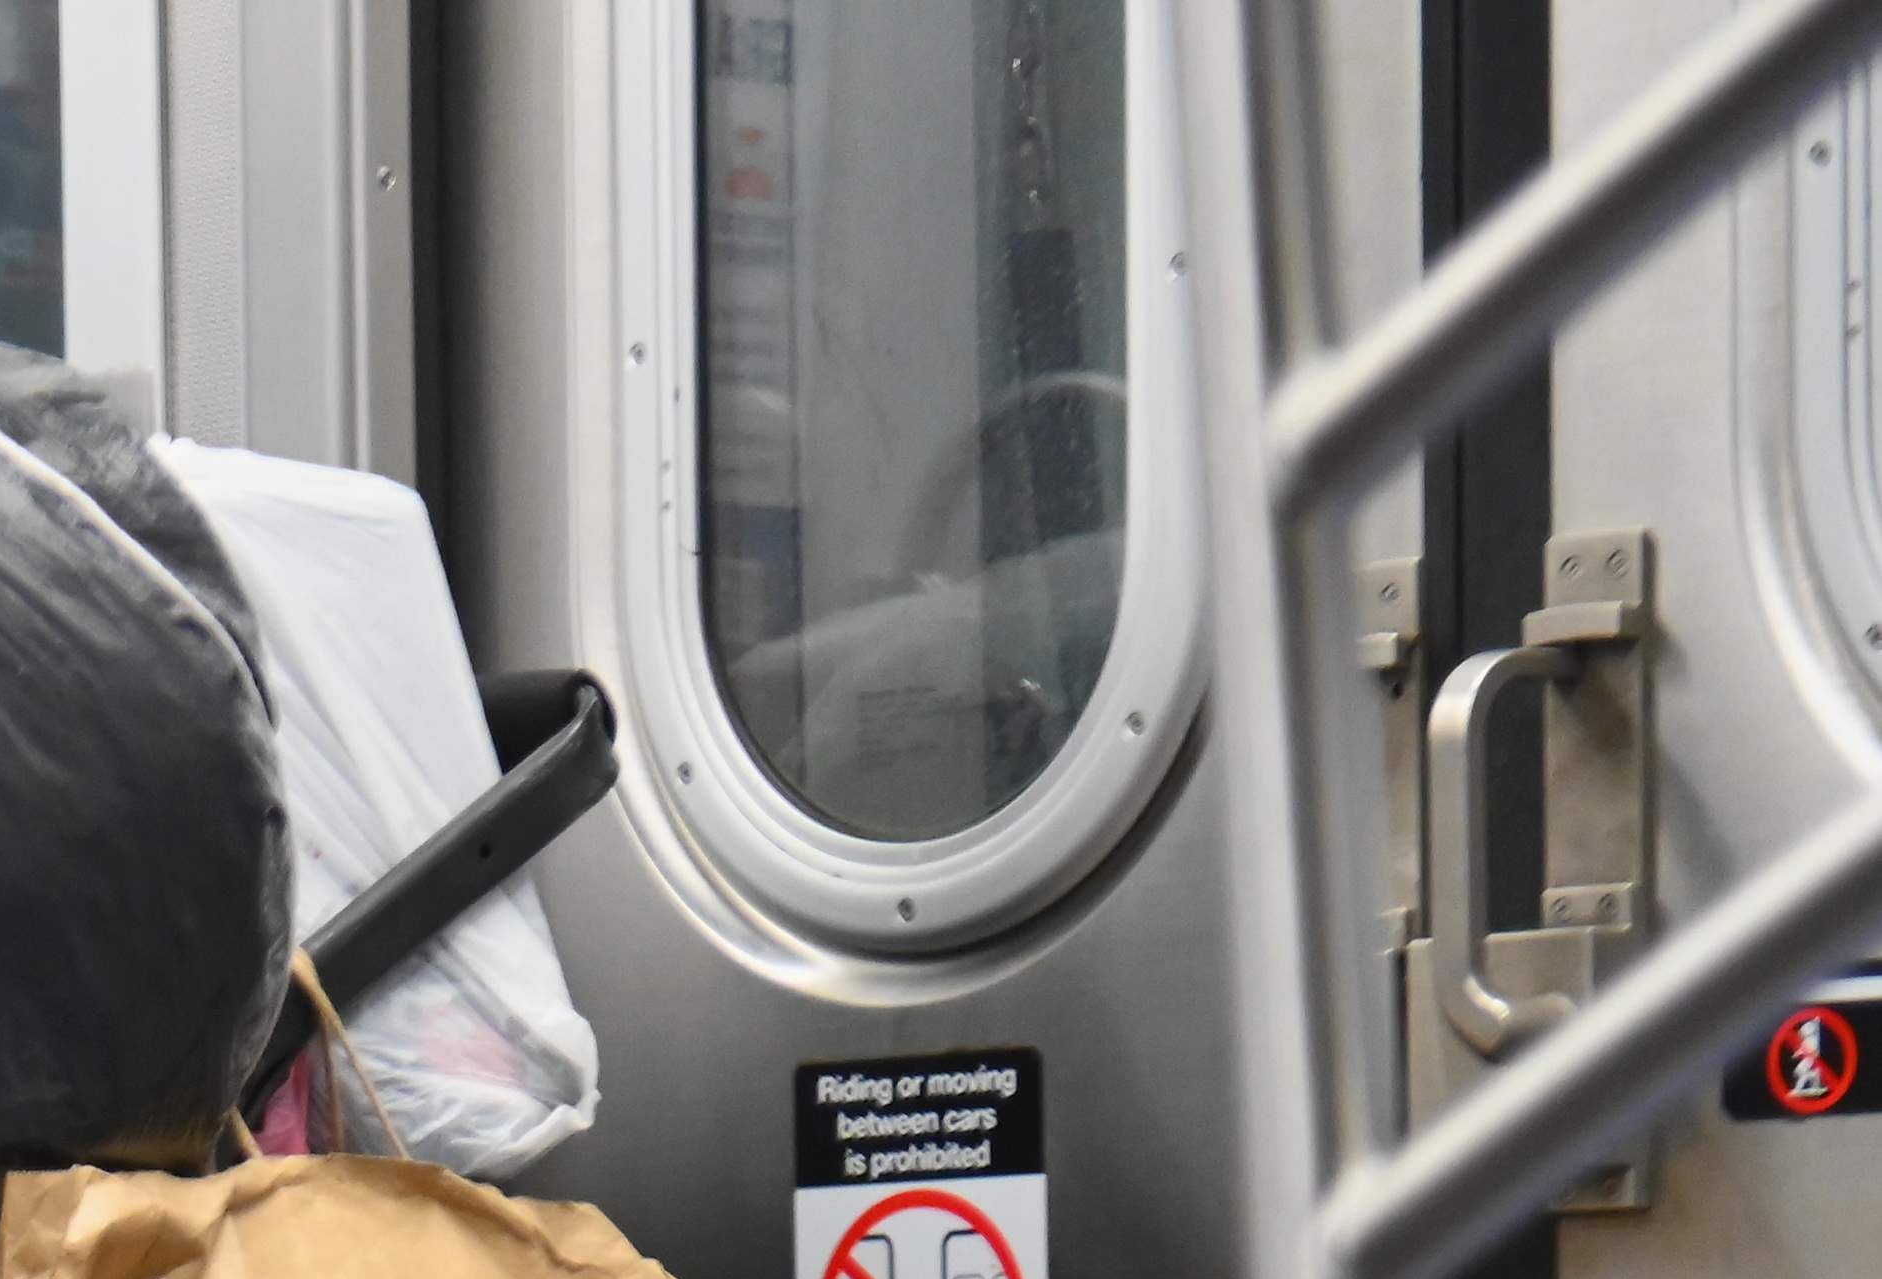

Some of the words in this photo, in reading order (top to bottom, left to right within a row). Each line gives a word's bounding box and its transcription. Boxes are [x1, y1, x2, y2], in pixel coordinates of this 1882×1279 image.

[816, 1074, 893, 1106] Riding
[896, 1077, 926, 1099] or
[927, 1064, 1018, 1099] moving
[836, 1110, 940, 1140] between
[942, 1107, 999, 1133] cars
[844, 1148, 868, 1175] is
[868, 1138, 992, 1180] prohibited
